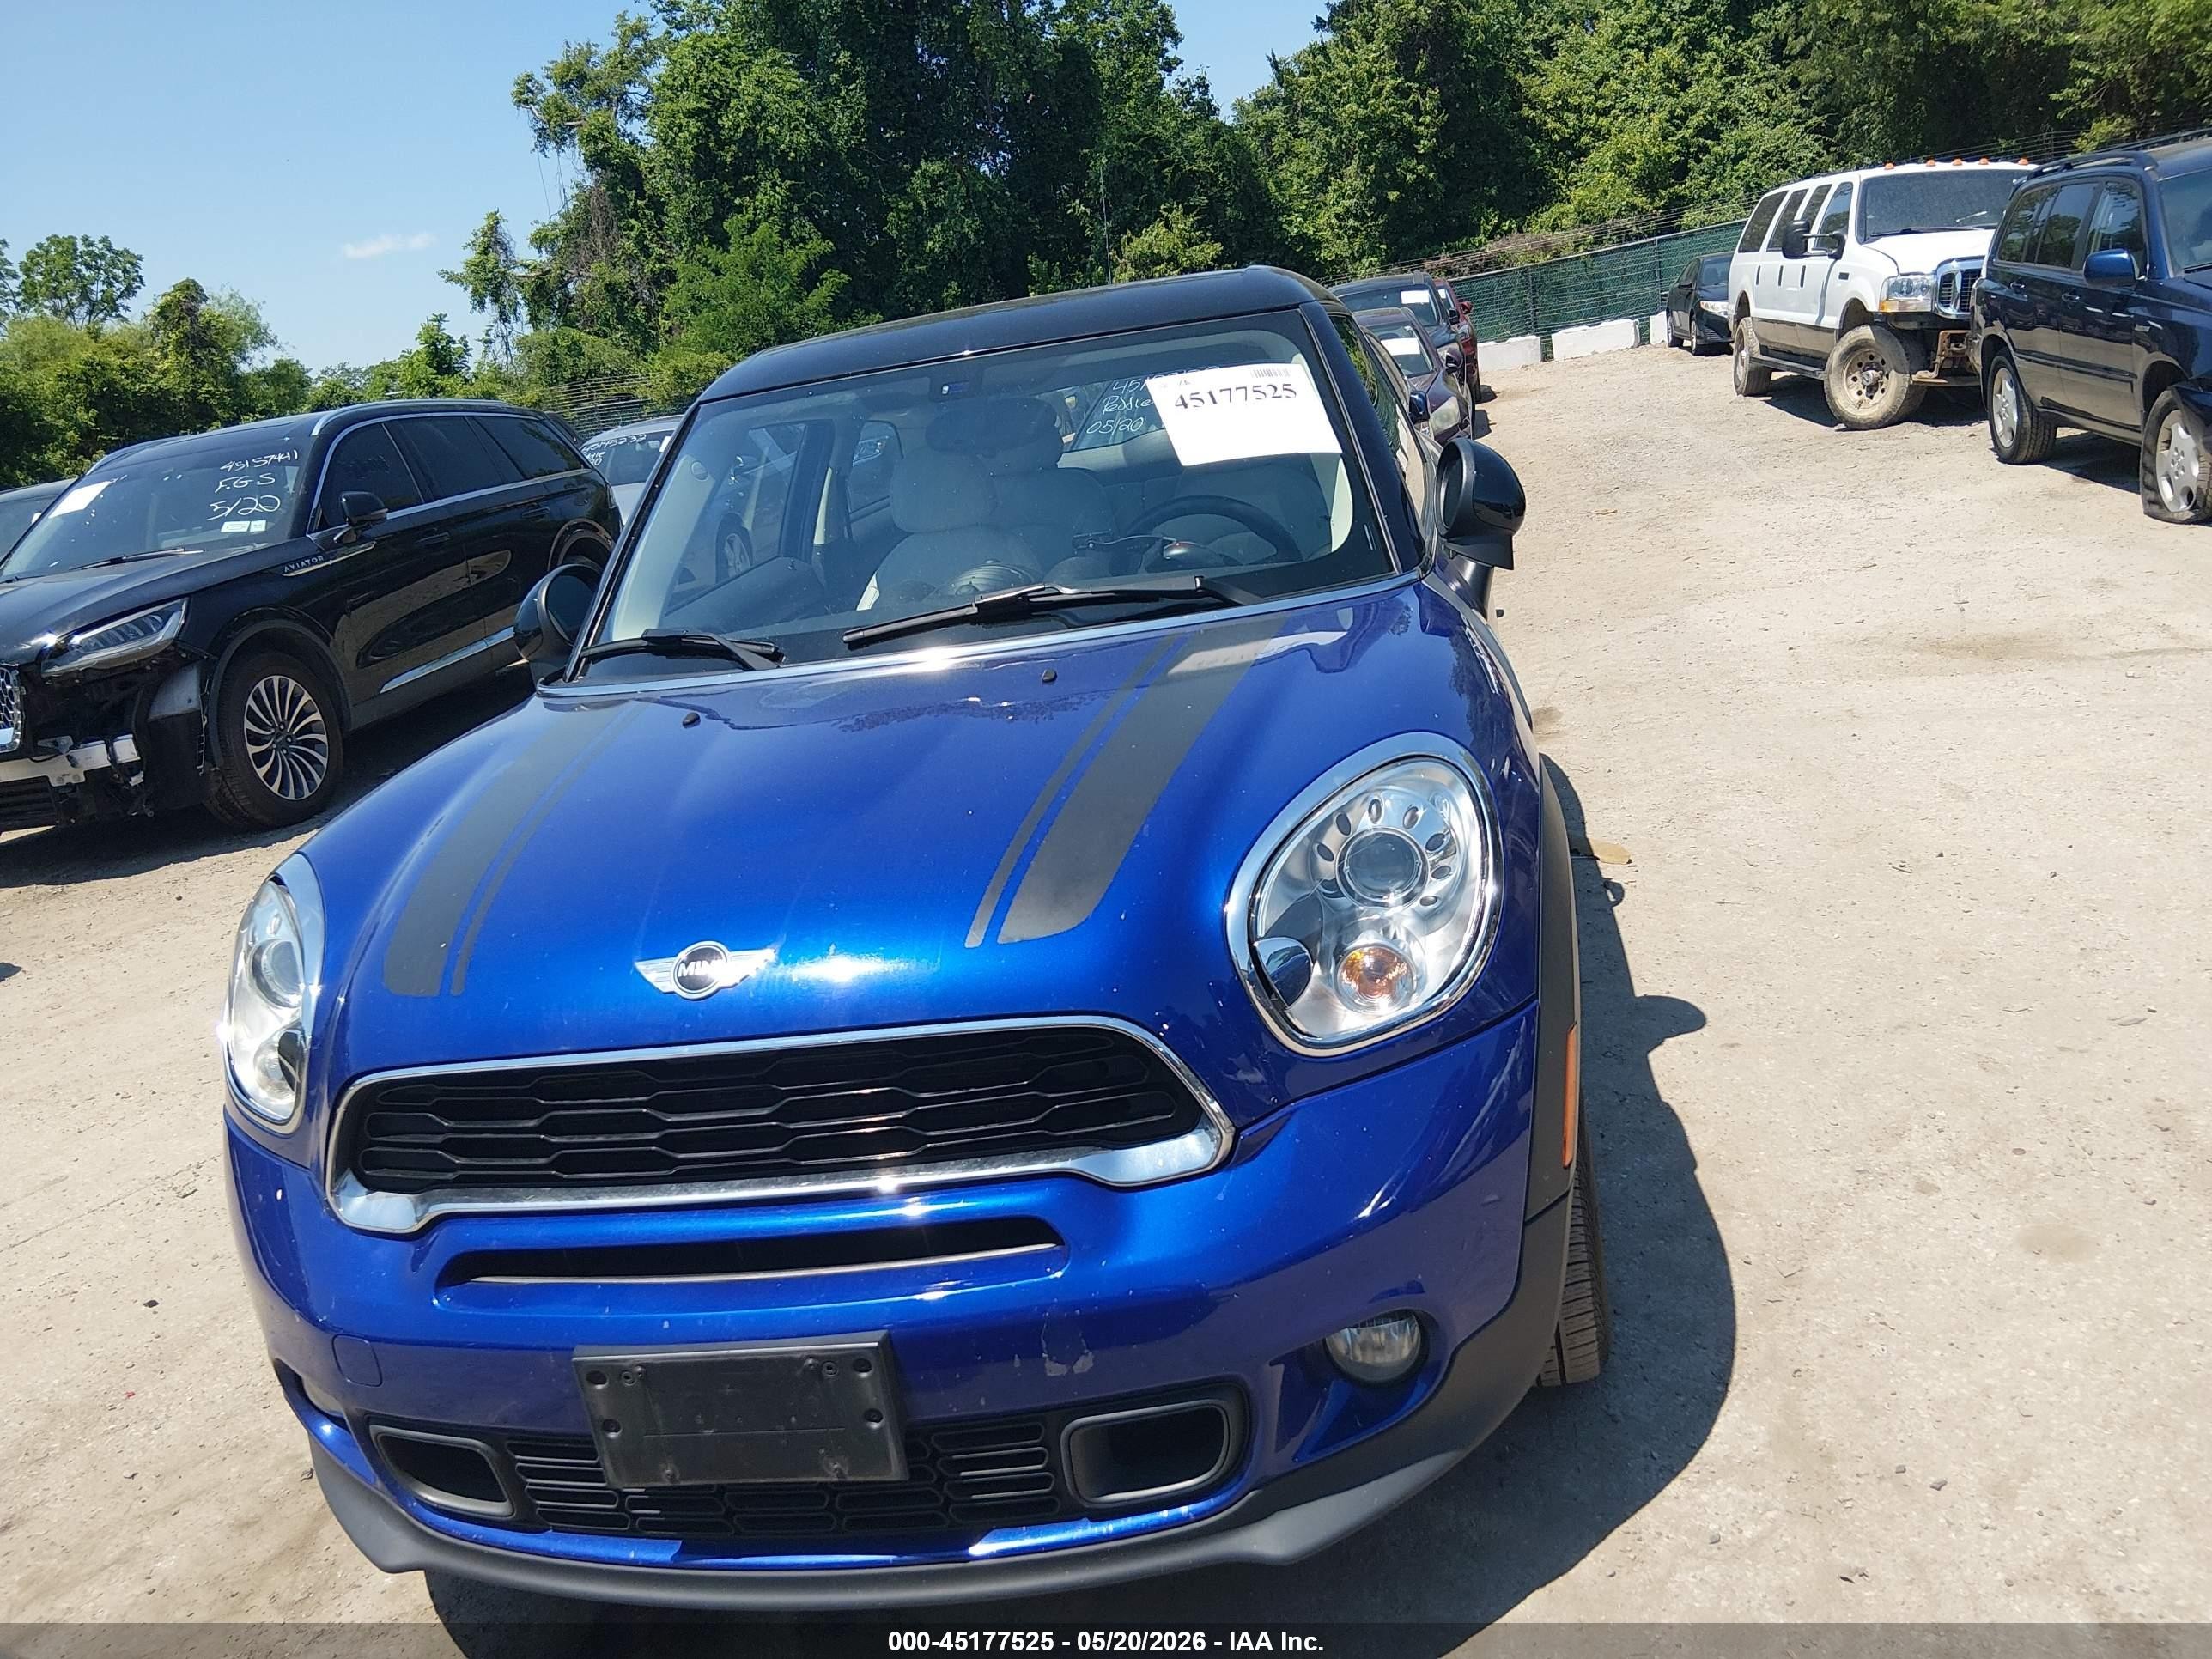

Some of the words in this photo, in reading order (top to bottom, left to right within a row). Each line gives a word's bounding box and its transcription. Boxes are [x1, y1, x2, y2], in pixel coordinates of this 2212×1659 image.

[1175, 383, 1297, 409] 45177525
[1086, 417, 1144, 435] 05/20
[284, 556, 324, 573] AVIATOR
[678, 958, 723, 977] MIN
